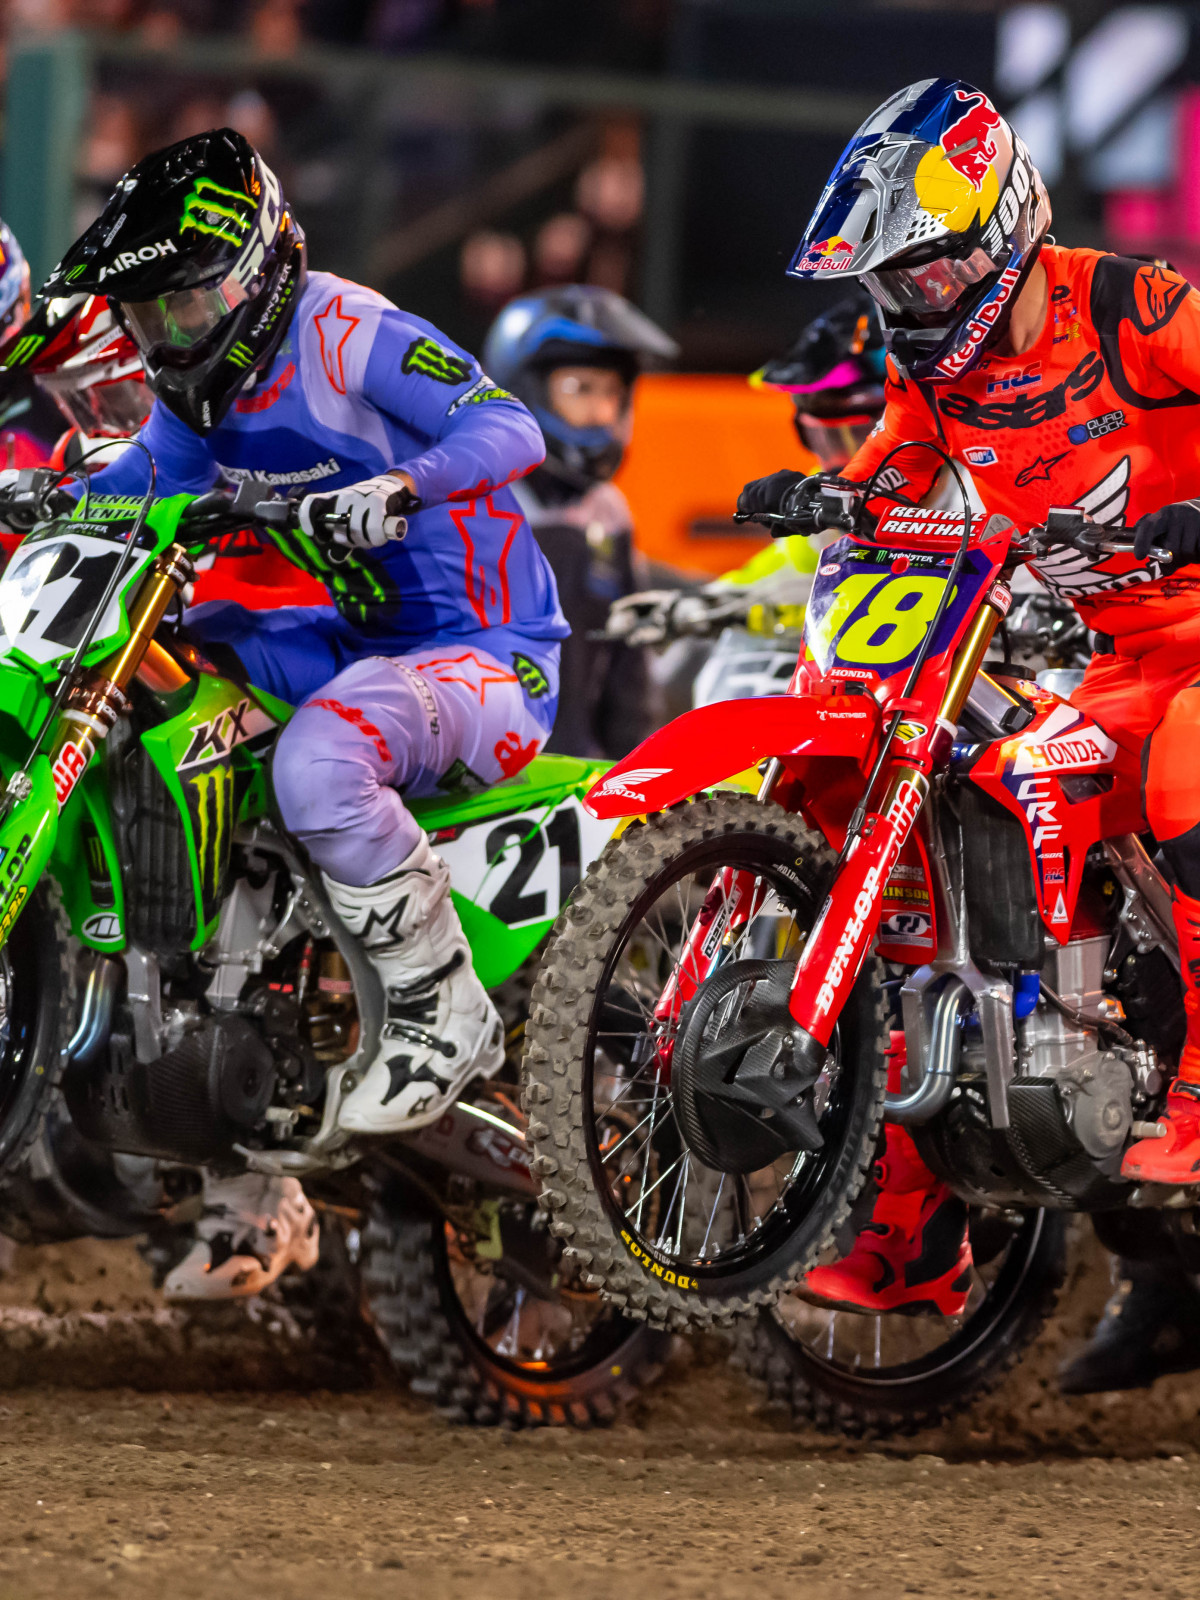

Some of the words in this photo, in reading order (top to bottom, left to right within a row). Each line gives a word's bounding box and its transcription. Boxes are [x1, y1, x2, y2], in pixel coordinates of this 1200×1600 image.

[99, 238, 179, 284] AIROH
[797, 257, 824, 271] Red
[820, 256, 854, 271] Bull
[251, 262, 293, 337] MONSTER
[935, 322, 991, 377] Red
[982, 265, 1022, 325] Bull
[985, 360, 1043, 394] HRC
[1086, 410, 1124, 430] QUAD
[1089, 419, 1128, 439] LOCK
[968, 450, 993, 463] 100%
[255, 458, 341, 486] Kawasaki
[881, 520, 977, 537] RENTHAL
[888, 506, 987, 522] RENTHAL
[888, 552, 934, 563] MONSTER
[805, 573, 959, 664] 18
[830, 668, 874, 680] HONDA
[827, 711, 867, 719] TRUETIMBER
[178, 699, 250, 770] KX
[1024, 738, 1109, 769] HONDA
[592, 788, 646, 802] HONDA
[1016, 777, 1063, 851] CRF
[485, 806, 581, 924] 21
[815, 866, 881, 1016] DUNLOP
[620, 1229, 691, 1290] DUNLOP
